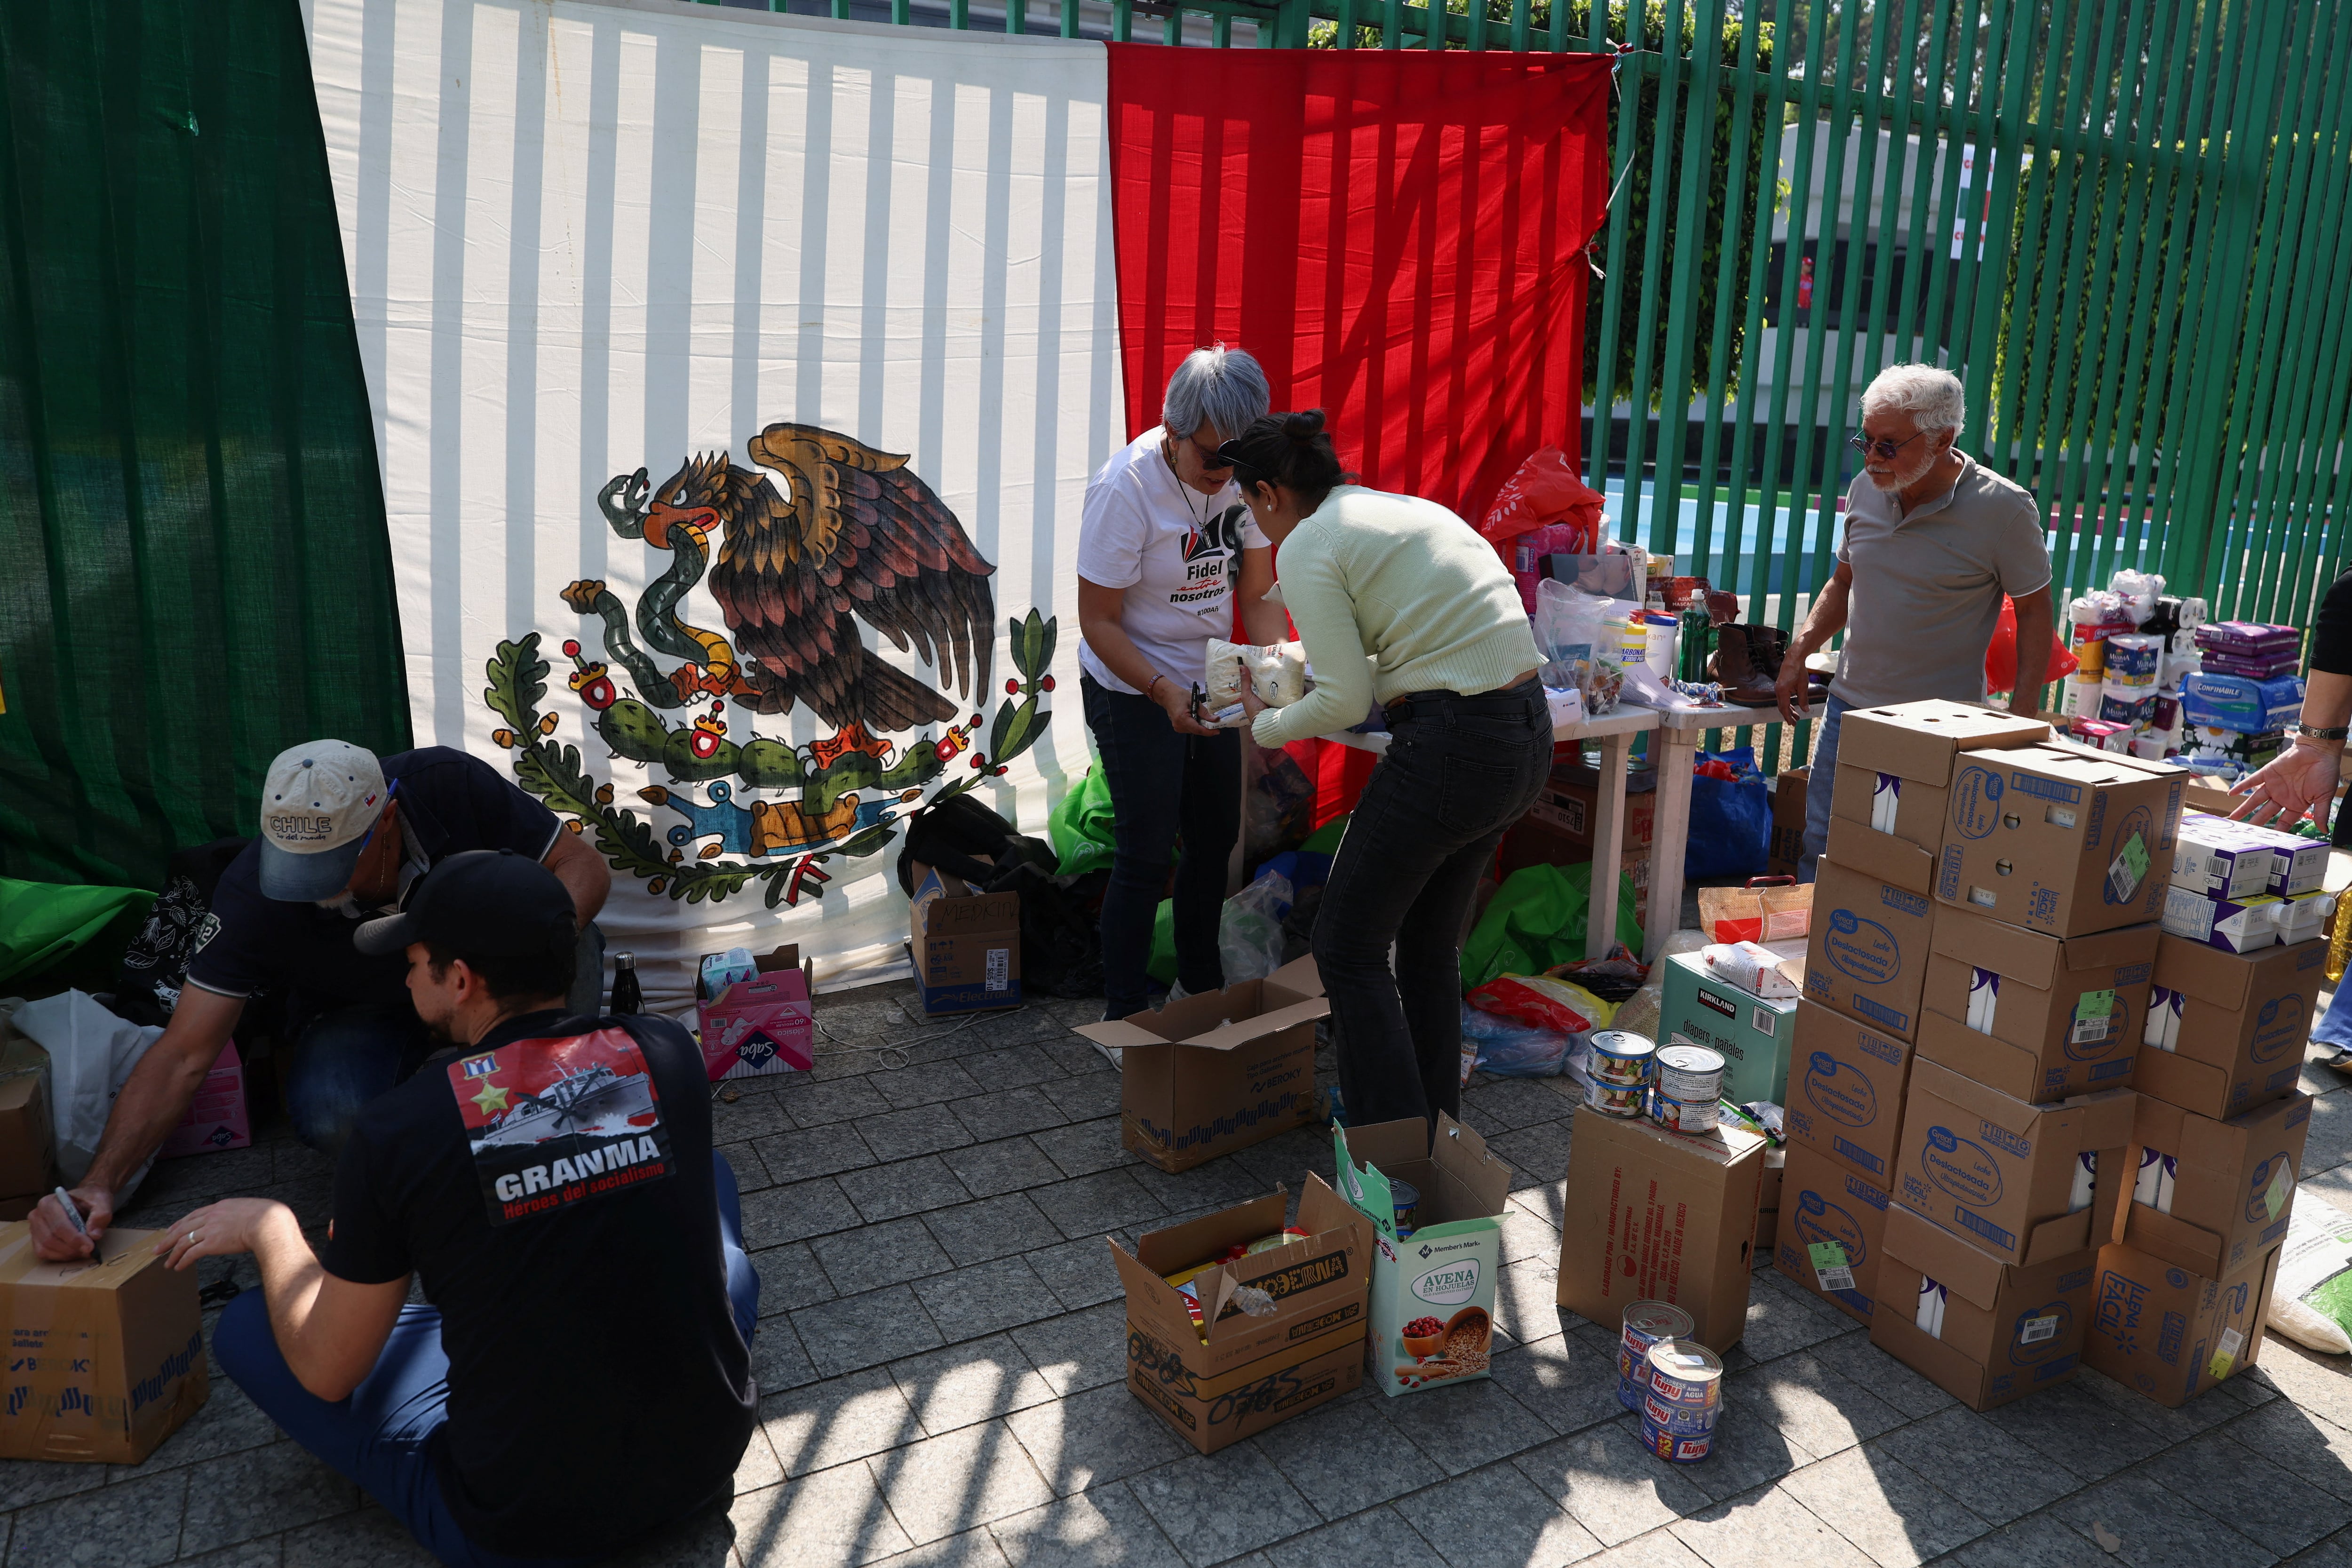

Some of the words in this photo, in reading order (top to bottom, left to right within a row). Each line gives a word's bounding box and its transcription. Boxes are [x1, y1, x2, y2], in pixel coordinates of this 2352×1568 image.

[1187, 560, 1223, 580] Fidel
[1176, 577, 1222, 591] entre
[1170, 586, 1226, 603] nosotros
[1197, 605, 1219, 616] #100Añ
[1967, 773, 1982, 828] Deslactosada
[270, 816, 332, 833] CHILE
[1558, 812, 1574, 826] 7510
[1977, 814, 1986, 831] Leche
[1781, 828, 1792, 862] Leche
[1789, 830, 1801, 865] Entera
[2039, 891, 2050, 918] FÁCIL
[2049, 893, 2058, 914] LLENA
[1835, 912, 1853, 926] Great
[1838, 921, 1852, 931] Value
[1832, 937, 1888, 967] Deslactosada
[1873, 939, 1891, 953] Leche
[1811, 969, 1825, 980] LLENA
[1841, 954, 1885, 979] Ultrapasteurizada
[1700, 990, 1735, 1013] KIRKLAND
[777, 1028, 804, 1037] clásica
[1684, 1019, 1710, 1043] diapers
[1715, 1036, 1744, 1061] pañales
[739, 1042, 774, 1060] Saba
[1260, 1059, 1271, 1068] para
[1272, 1052, 1292, 1062] archivo
[1293, 1045, 1310, 1055] muerto
[1260, 1063, 1283, 1075] Galletera
[1814, 1054, 1833, 1069] Great
[1817, 1062, 1832, 1074] Value
[1267, 1067, 1302, 1089] BEROKY
[1812, 1078, 1865, 1111] Deslactosada
[1851, 1084, 1867, 1097] Leche
[1792, 1107, 1806, 1119] LLENA
[1821, 1096, 1863, 1122] Ultrapasteurizada
[1633, 1119, 1664, 1132] CONTAINS
[1792, 1114, 1809, 1129] FÁCIL
[211, 1131, 231, 1142] Saba
[1667, 1131, 1688, 1141] LATAS
[1931, 1129, 1953, 1145] Great
[1936, 1138, 1952, 1150] Value
[1698, 1143, 1731, 1156] CONTIENE
[495, 1135, 660, 1202] GRANMA
[1930, 1154, 1989, 1190] Deslactosada
[1973, 1162, 1991, 1176] Leche
[1907, 1174, 1922, 1187] LLENA
[1940, 1172, 1987, 1202] Ultrapasteurizada
[503, 1193, 559, 1220] Héroes
[564, 1182, 587, 1203] del
[590, 1162, 665, 1194] socialismo
[1649, 1179, 1658, 1201] PARQUE
[1906, 1181, 1926, 1198] FÁCIL
[1803, 1193, 1821, 1209] Great
[1806, 1201, 1820, 1213] Value
[1361, 1207, 1381, 1224] Member's
[1654, 1204, 1666, 1238] MANZANILLO,
[1675, 1202, 1687, 1229] MEXICO
[1623, 1206, 1633, 1251] MARINDUSTRIAS
[1644, 1216, 1653, 1245] GUTIÉRREZ
[1675, 1228, 1684, 1237] IN
[1840, 1224, 1856, 1239] Leche
[1602, 1257, 1613, 1297] ELABORADO
[1608, 1180, 1621, 1238] MANUFACTURED
[1434, 1243, 1462, 1253] Member's
[1640, 1245, 1649, 1264] SUÁREZ
[1651, 1238, 1660, 1271] FONDEPORT,
[1673, 1239, 1683, 1257] MADE
[1423, 1269, 1475, 1287] AVENA
[1639, 1264, 1647, 1287] ANTONIO
[1668, 1258, 1680, 1284] MÉXICO
[1436, 1280, 1475, 1291] HOJUELAS
[1648, 1272, 1657, 1300] INDUSTRIAL
[1669, 1284, 1677, 1294] EN
[2099, 1276, 2128, 1329] FÁCIL
[2124, 1286, 2144, 1329] LLENA
[1291, 1311, 1341, 1336] MODERNA
[1625, 1327, 1648, 1355] Tuny
[1632, 1332, 1652, 1344] EXPRESS
[1653, 1371, 1682, 1399] Tuny
[1662, 1376, 1687, 1389] EXPRESS
[1136, 1374, 1179, 1416] MODERNA
[1646, 1394, 1670, 1424] Tuny
[1653, 1400, 1675, 1414] EXPRESS
[1643, 1428, 1655, 1442] AGUA
[1659, 1432, 1673, 1440] Rinde
[1693, 1435, 1712, 1445] EXPRESS
[1658, 1437, 1672, 1452] +2
[1682, 1441, 1709, 1457] Tuny
